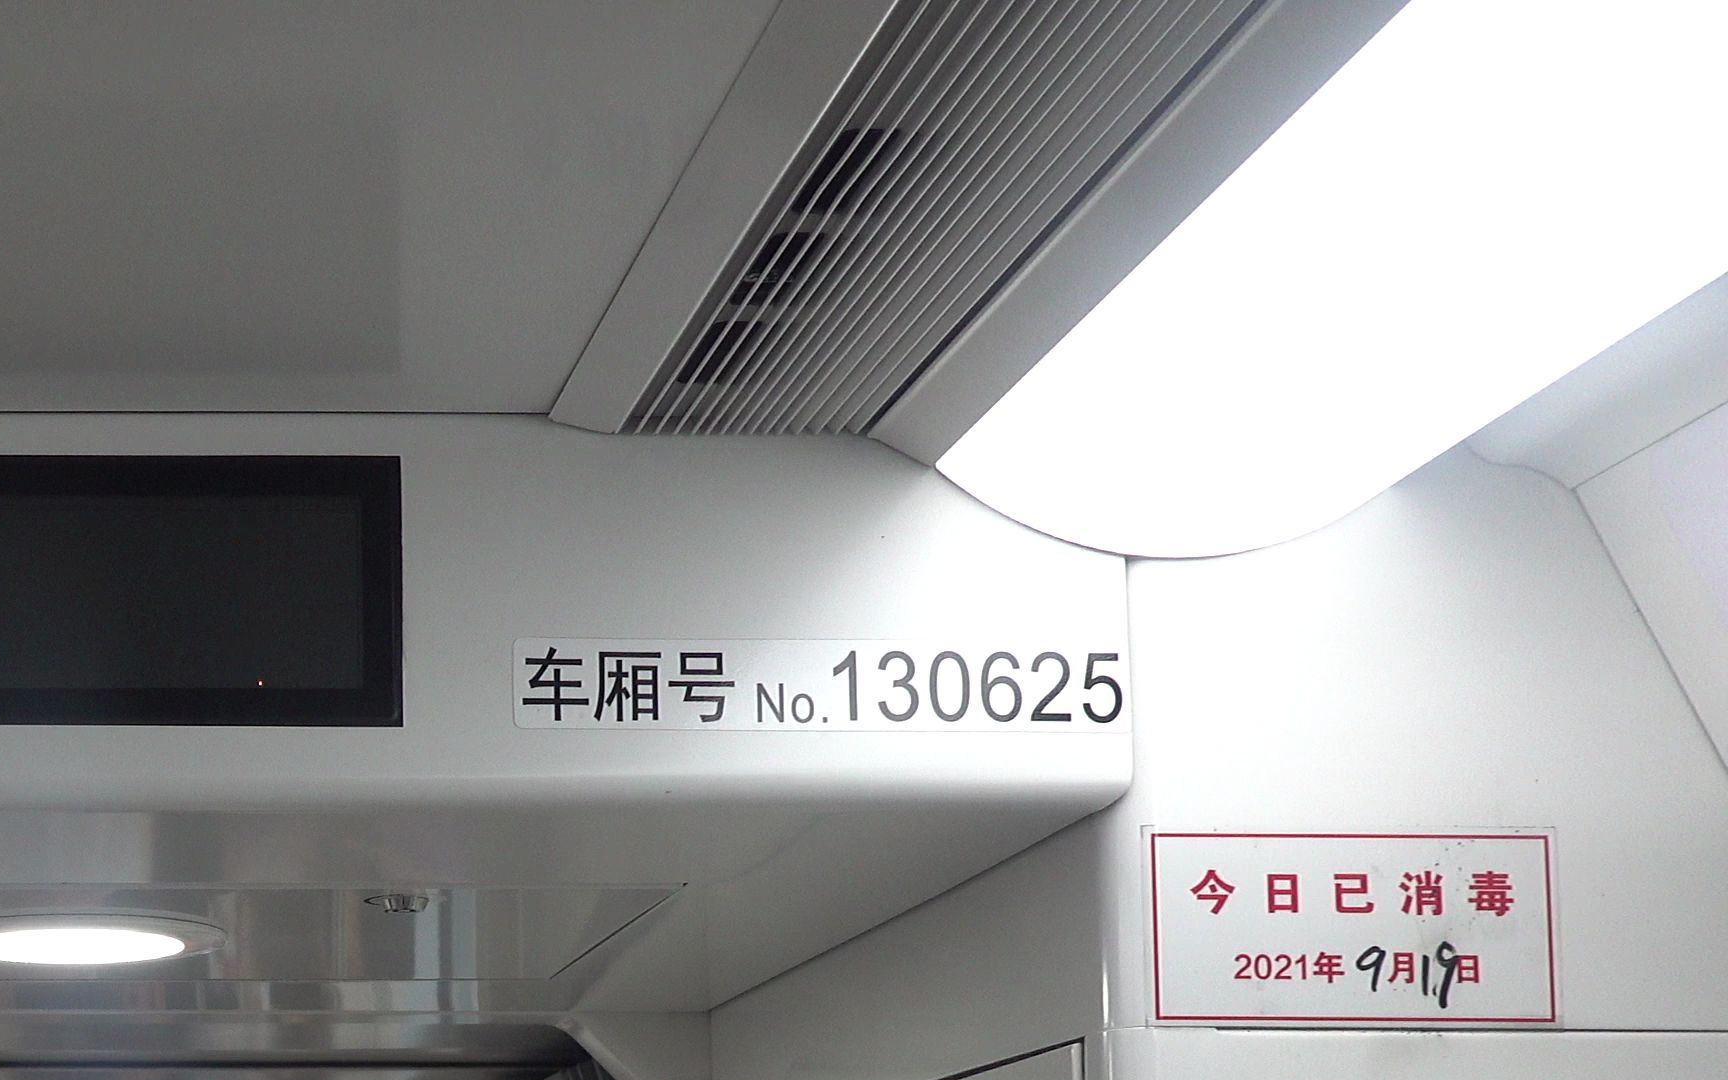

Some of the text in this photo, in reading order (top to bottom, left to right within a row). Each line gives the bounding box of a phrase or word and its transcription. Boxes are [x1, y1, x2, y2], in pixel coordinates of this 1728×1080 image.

[521, 646, 735, 724] 车厢号
[1189, 869, 1515, 917] 今日已消毒
